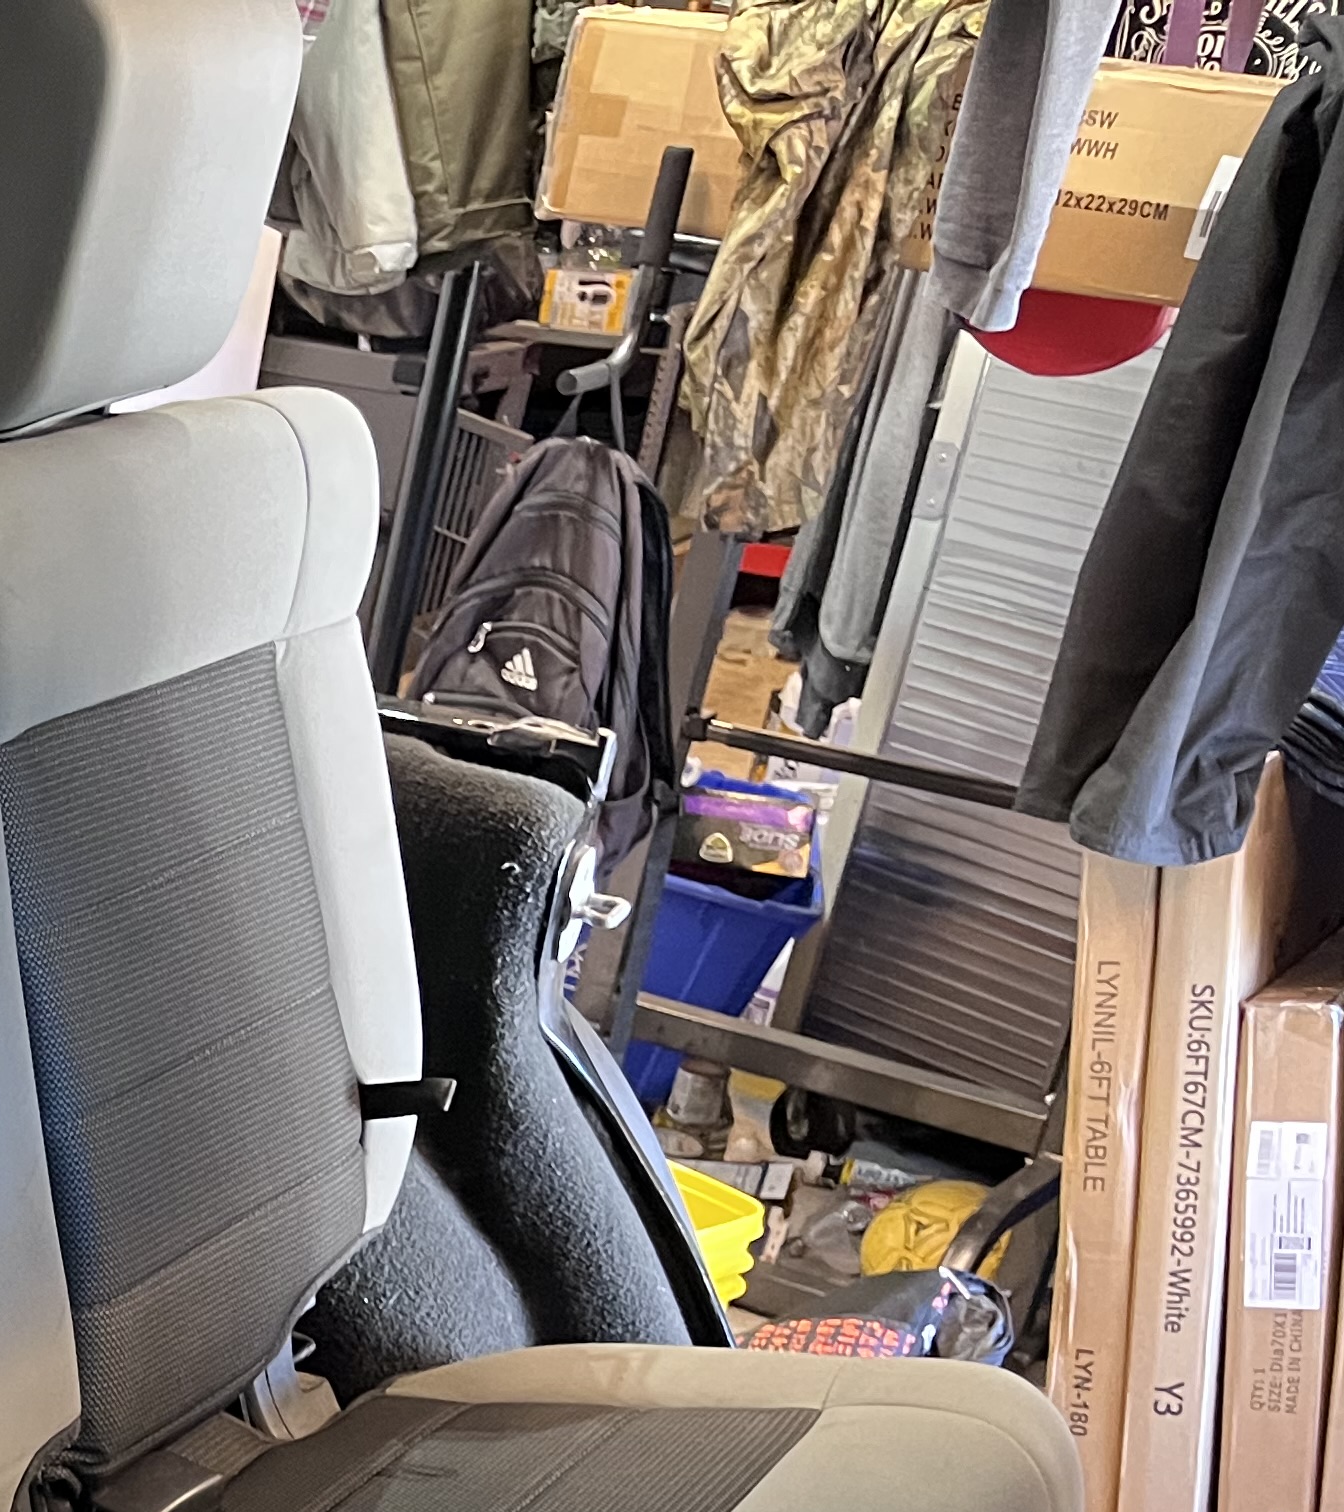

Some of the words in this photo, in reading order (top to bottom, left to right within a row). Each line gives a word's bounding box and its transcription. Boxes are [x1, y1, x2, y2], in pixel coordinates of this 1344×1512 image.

[1082, 1109, 1110, 1193] TABLE
[1163, 983, 1216, 1334] SKU:6FT67CM-7365992-White
[1289, 1309, 1304, 1353] CHINA
[1287, 1356, 1301, 1372] IN
[1069, 1348, 1095, 1437] LYN-180
[1152, 1381, 1185, 1417] Y3
[1285, 1376, 1301, 1415] MADE
